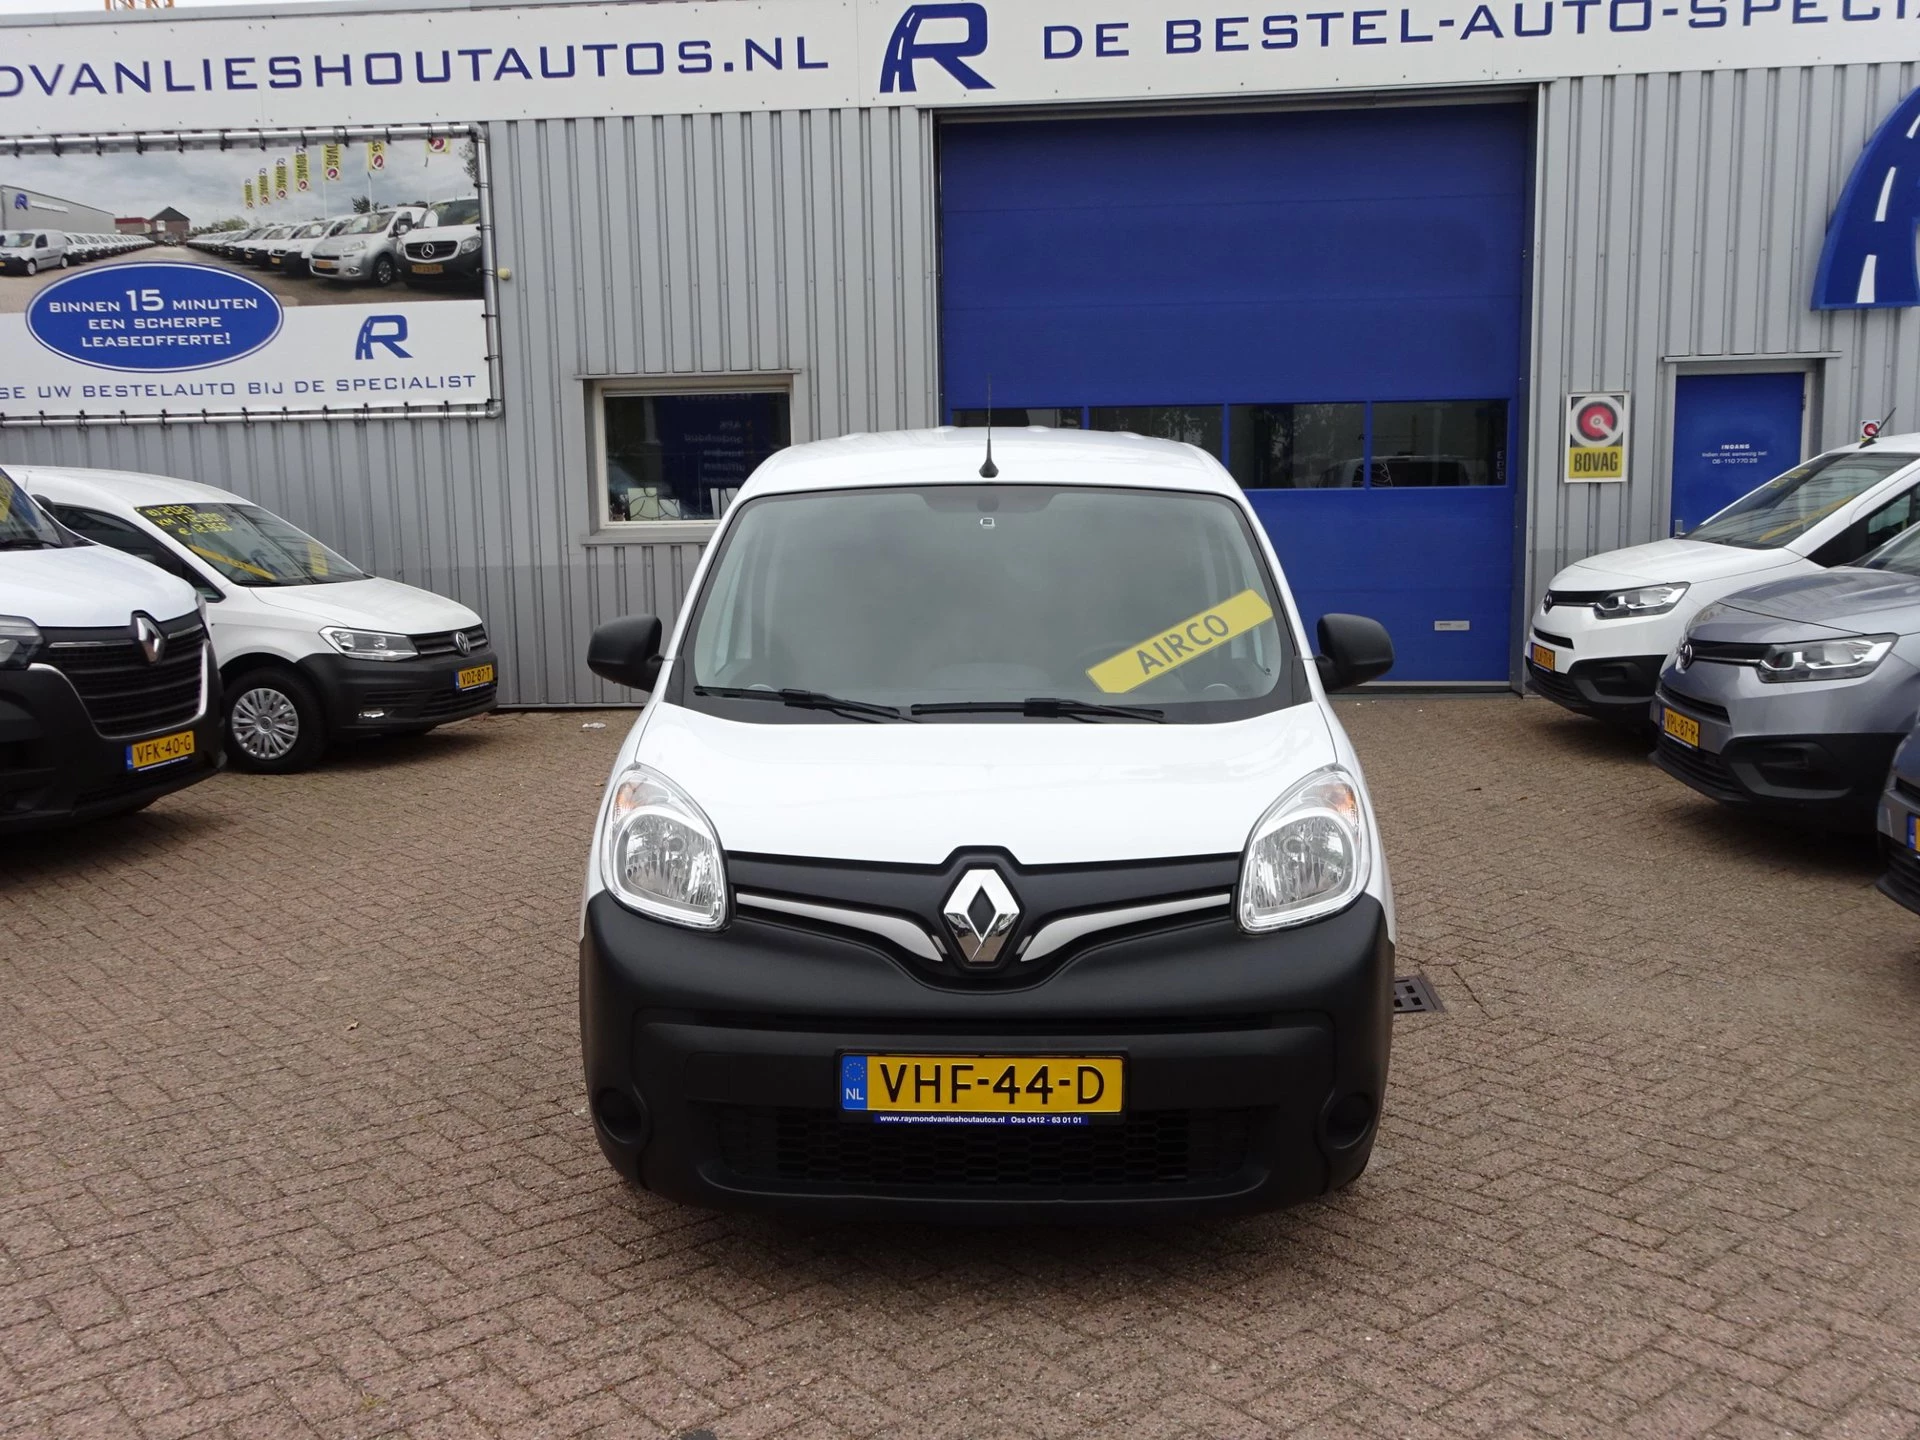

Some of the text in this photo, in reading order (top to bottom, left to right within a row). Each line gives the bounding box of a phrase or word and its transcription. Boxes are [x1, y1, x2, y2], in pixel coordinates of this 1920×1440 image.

[1044, 0, 1920, 59] DE BESTEL-AUTO-SPECI
[49, 289, 258, 313] BINNEN 15 MINUTEN
[88, 316, 222, 330] EEN SCHERPE
[81, 332, 231, 348] LEASEOFFERTE!
[37, 385, 72, 398] UW
[83, 382, 236, 398] BESTELAUTO
[248, 381, 284, 394] BIJ
[294, 380, 325, 393] DE
[336, 375, 477, 392] SPECIALIST
[1574, 451, 1618, 472] BOVAG
[1136, 614, 1229, 675] AIRCO
[135, 734, 191, 764] VFK-40-G
[845, 1063, 1106, 1105] NL VHF-44-D
[880, 1115, 1005, 1124] www.raymondvanlieshoutautos.nl
[1010, 1116, 1026, 1124] Oss
[1027, 1116, 1045, 1124] 0412
[1051, 1116, 1062, 1124] 63
[1062, 1116, 1072, 1124] 01
[1072, 1116, 1082, 1124] 01
